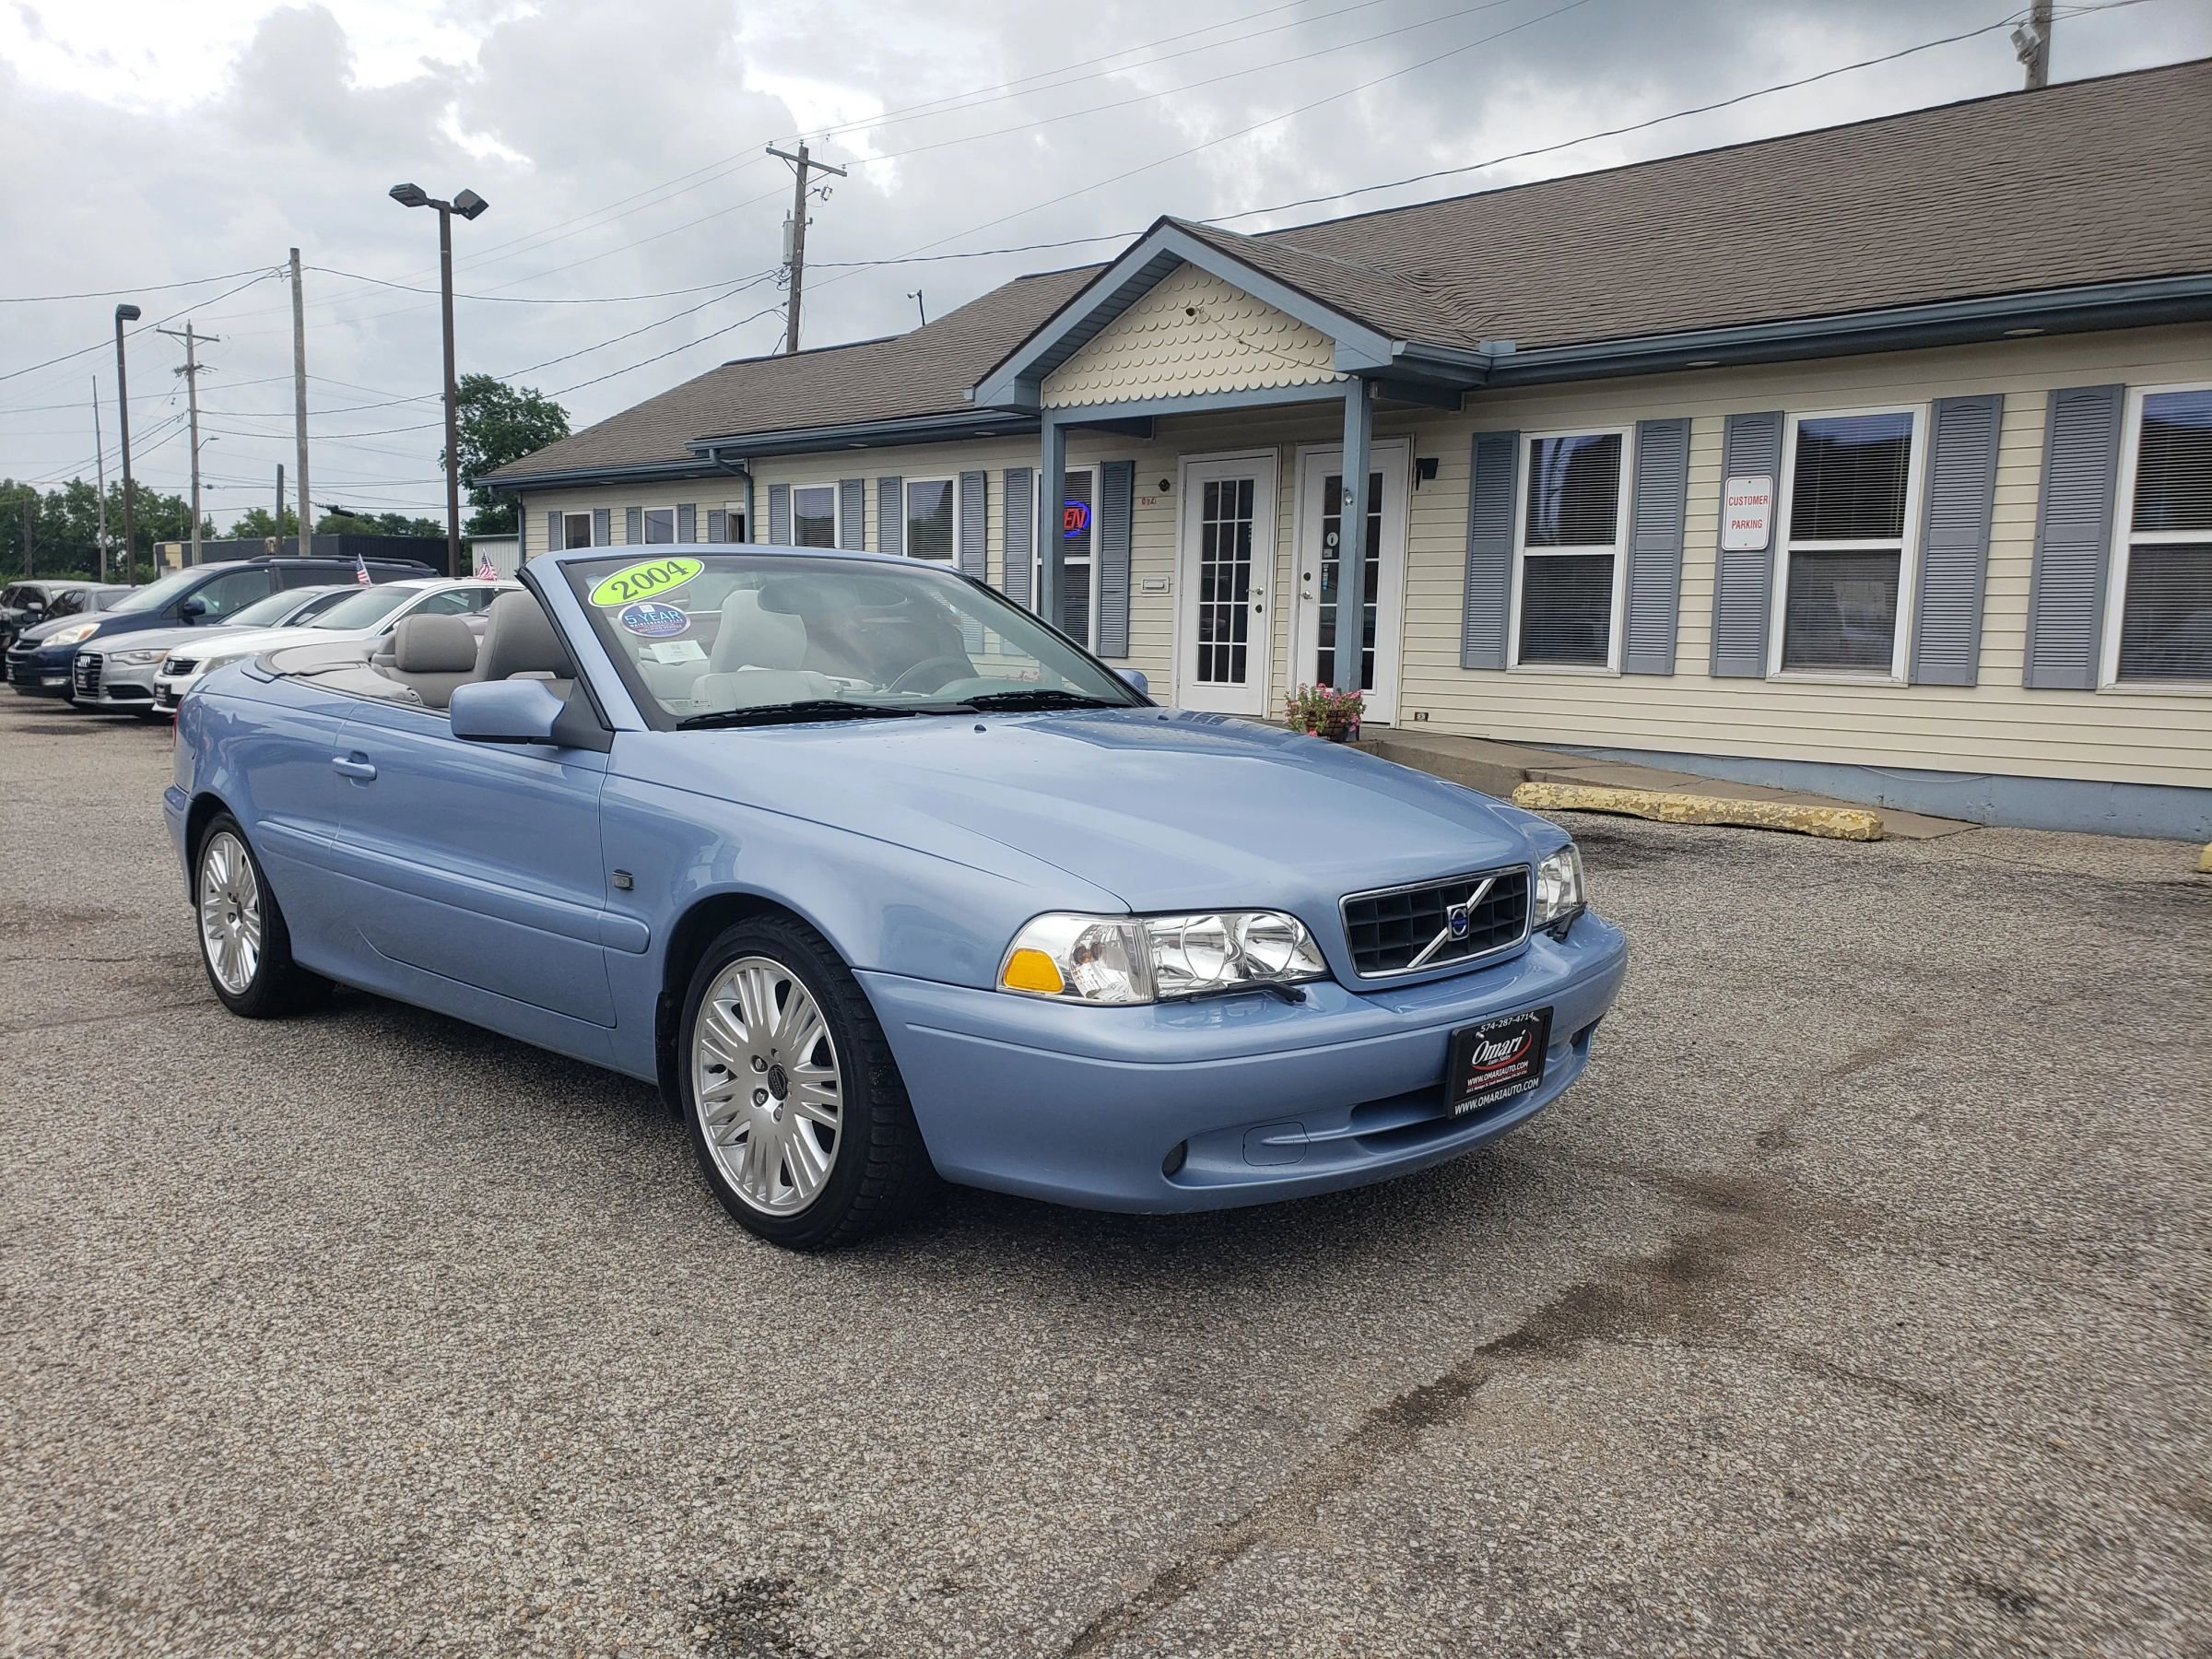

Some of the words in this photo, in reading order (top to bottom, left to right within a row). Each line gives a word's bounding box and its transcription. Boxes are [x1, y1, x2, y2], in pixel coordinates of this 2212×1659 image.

[1728, 495, 1769, 506] CUSTOMER
[1064, 508, 1086, 529] EN
[1731, 519, 1763, 530] PARKING
[611, 560, 689, 601] 2004
[624, 615, 638, 625] 5
[637, 610, 681, 623] YEAR
[1480, 1012, 1534, 1032] 574-287-4714
[1472, 1030, 1526, 1065] Omari
[1467, 1060, 1529, 1087] WWW.OMARIAUTO.COM
[1454, 1077, 1539, 1115] WWW.OMARIAUTO.COM
